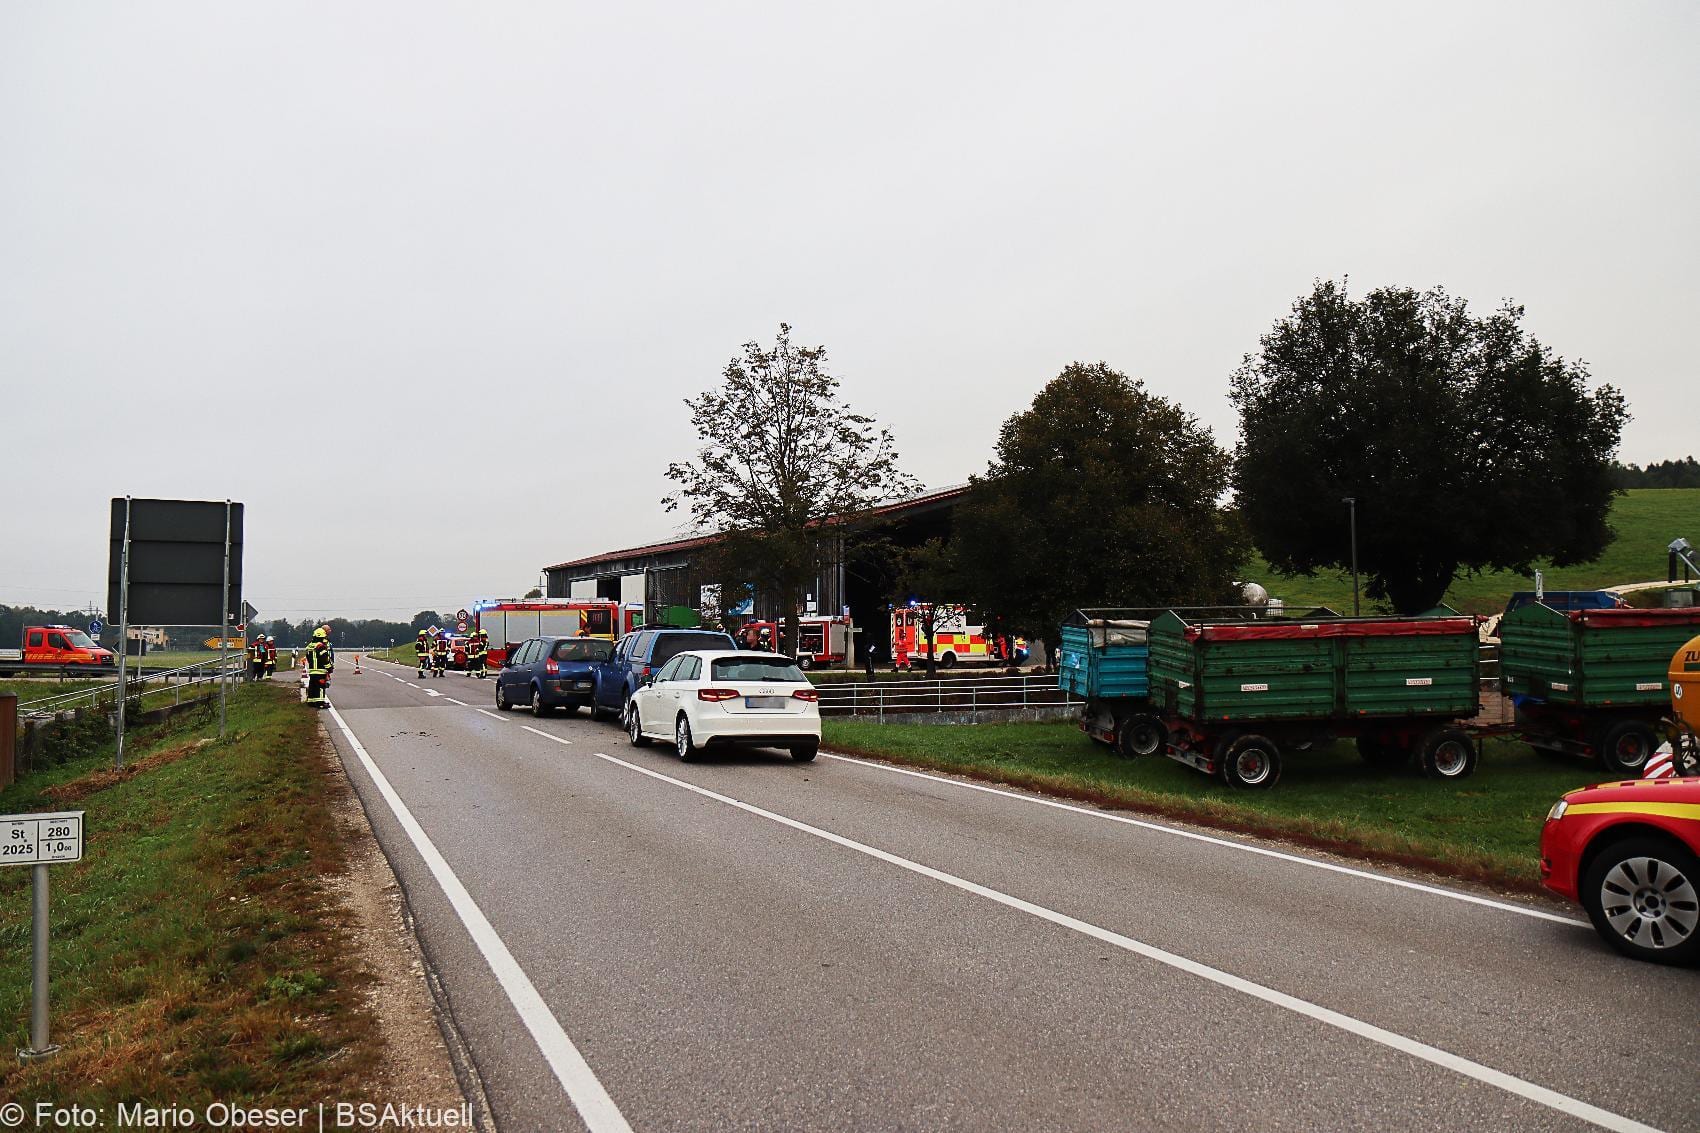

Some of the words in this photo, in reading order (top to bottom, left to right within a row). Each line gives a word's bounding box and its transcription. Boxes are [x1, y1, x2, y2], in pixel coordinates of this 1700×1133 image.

[11, 830, 27, 843] St.
[47, 827, 70, 838] 280
[3, 844, 33, 856] 2025
